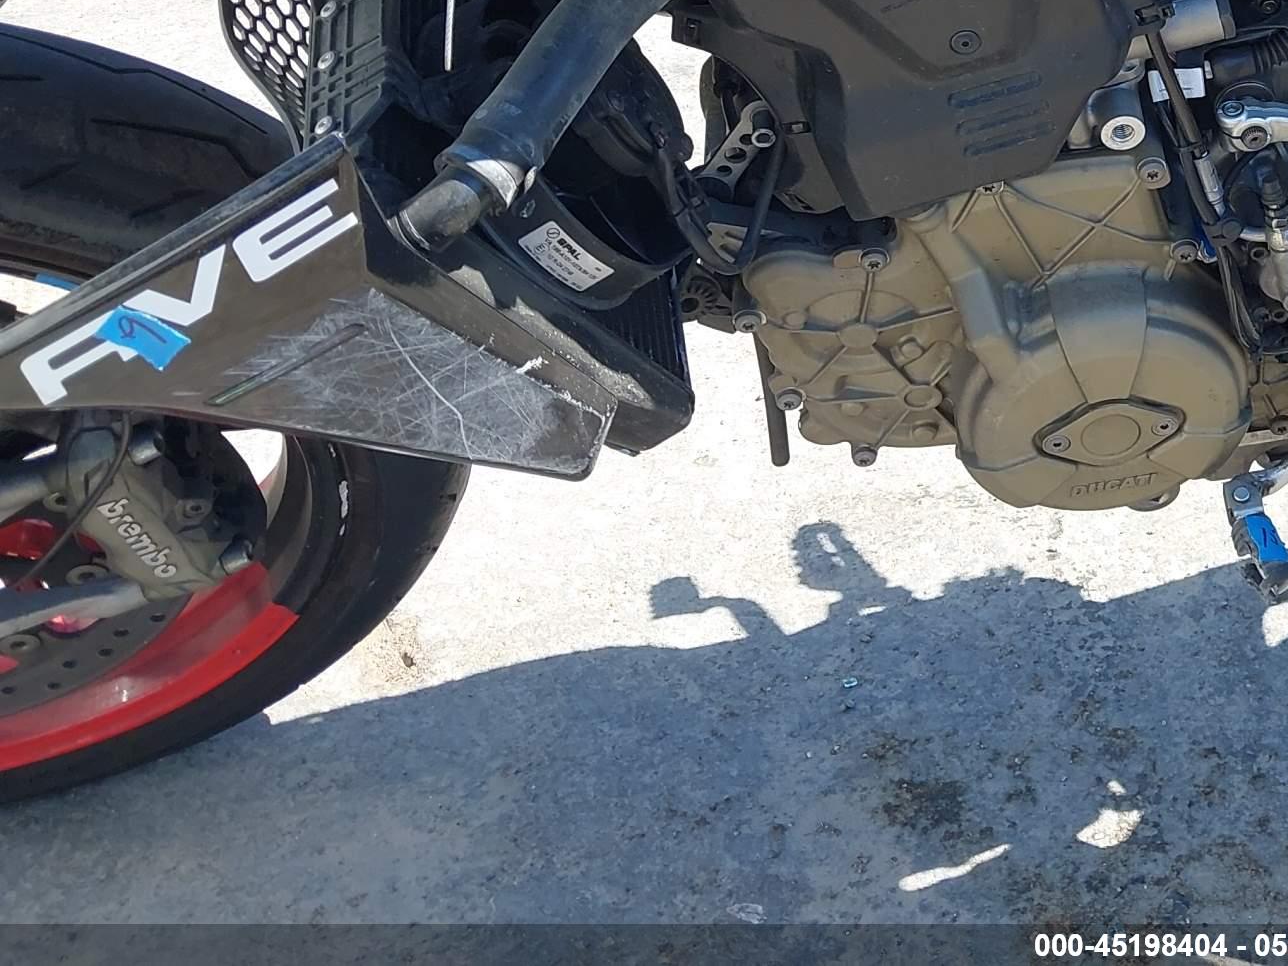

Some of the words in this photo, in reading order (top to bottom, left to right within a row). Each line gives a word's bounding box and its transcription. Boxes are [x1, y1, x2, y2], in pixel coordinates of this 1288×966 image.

[556, 236, 582, 261] SPAL
[1070, 472, 1158, 497] DUCATI
[97, 498, 177, 578] brembo
